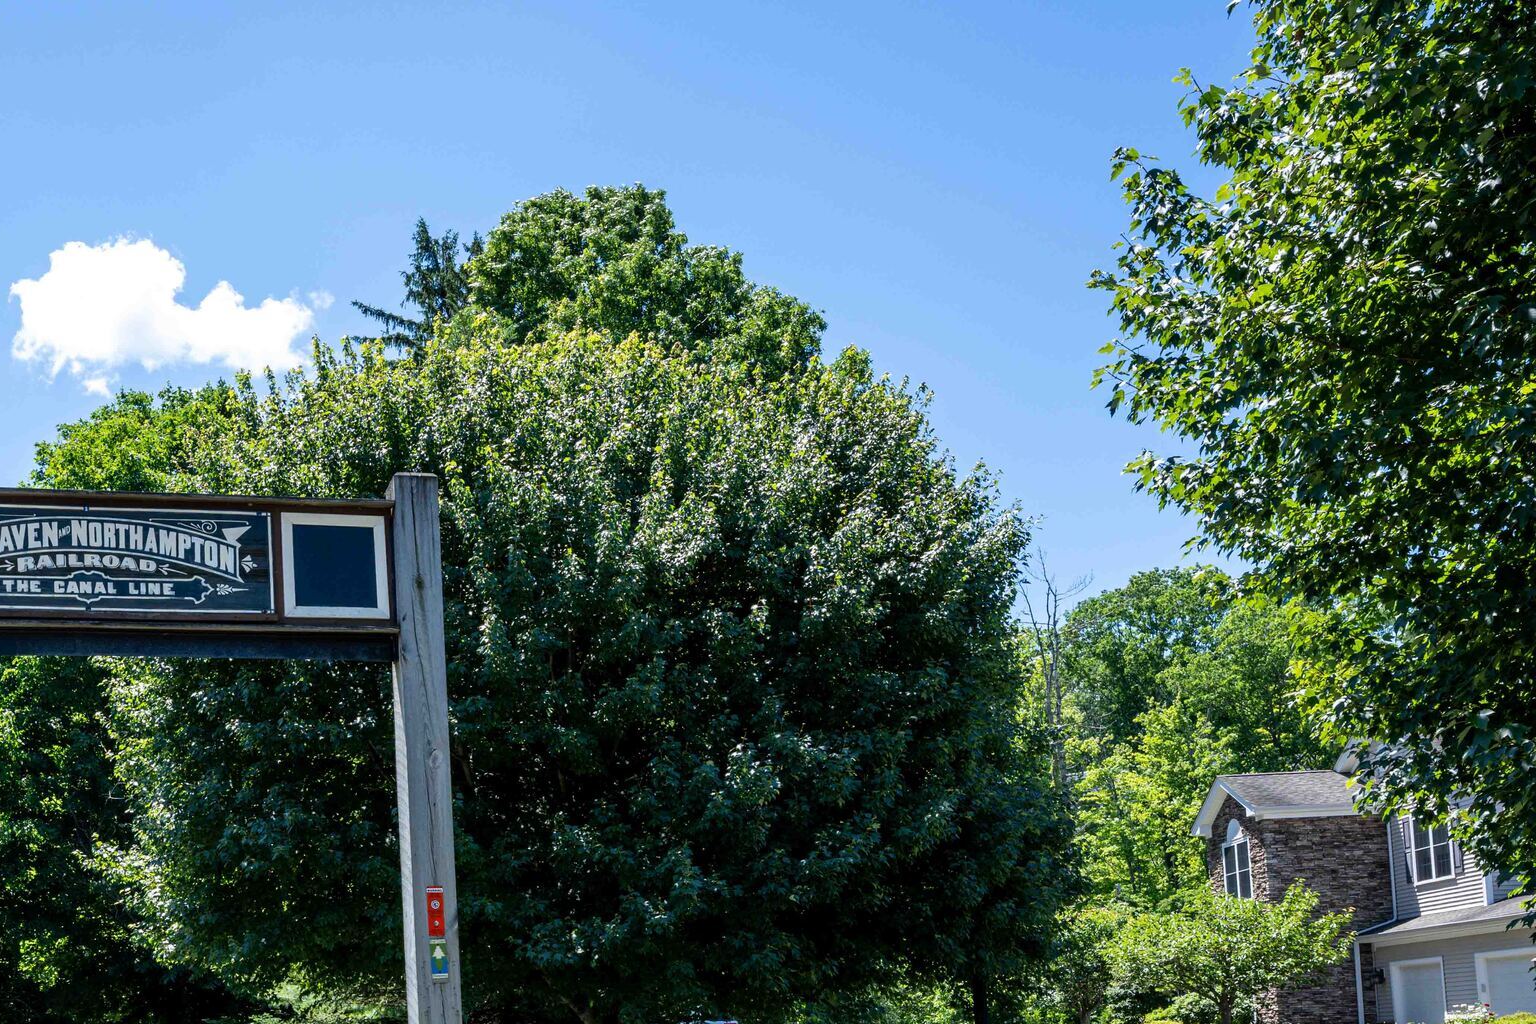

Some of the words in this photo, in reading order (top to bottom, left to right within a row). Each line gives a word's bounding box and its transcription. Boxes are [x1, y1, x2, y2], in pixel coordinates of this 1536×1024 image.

[70, 519, 235, 575] NORTHAMPTON
[17, 553, 157, 573] RAILROAD
[3, 579, 42, 593] THE
[53, 580, 117, 594] CANAL
[128, 582, 176, 596] LINE
